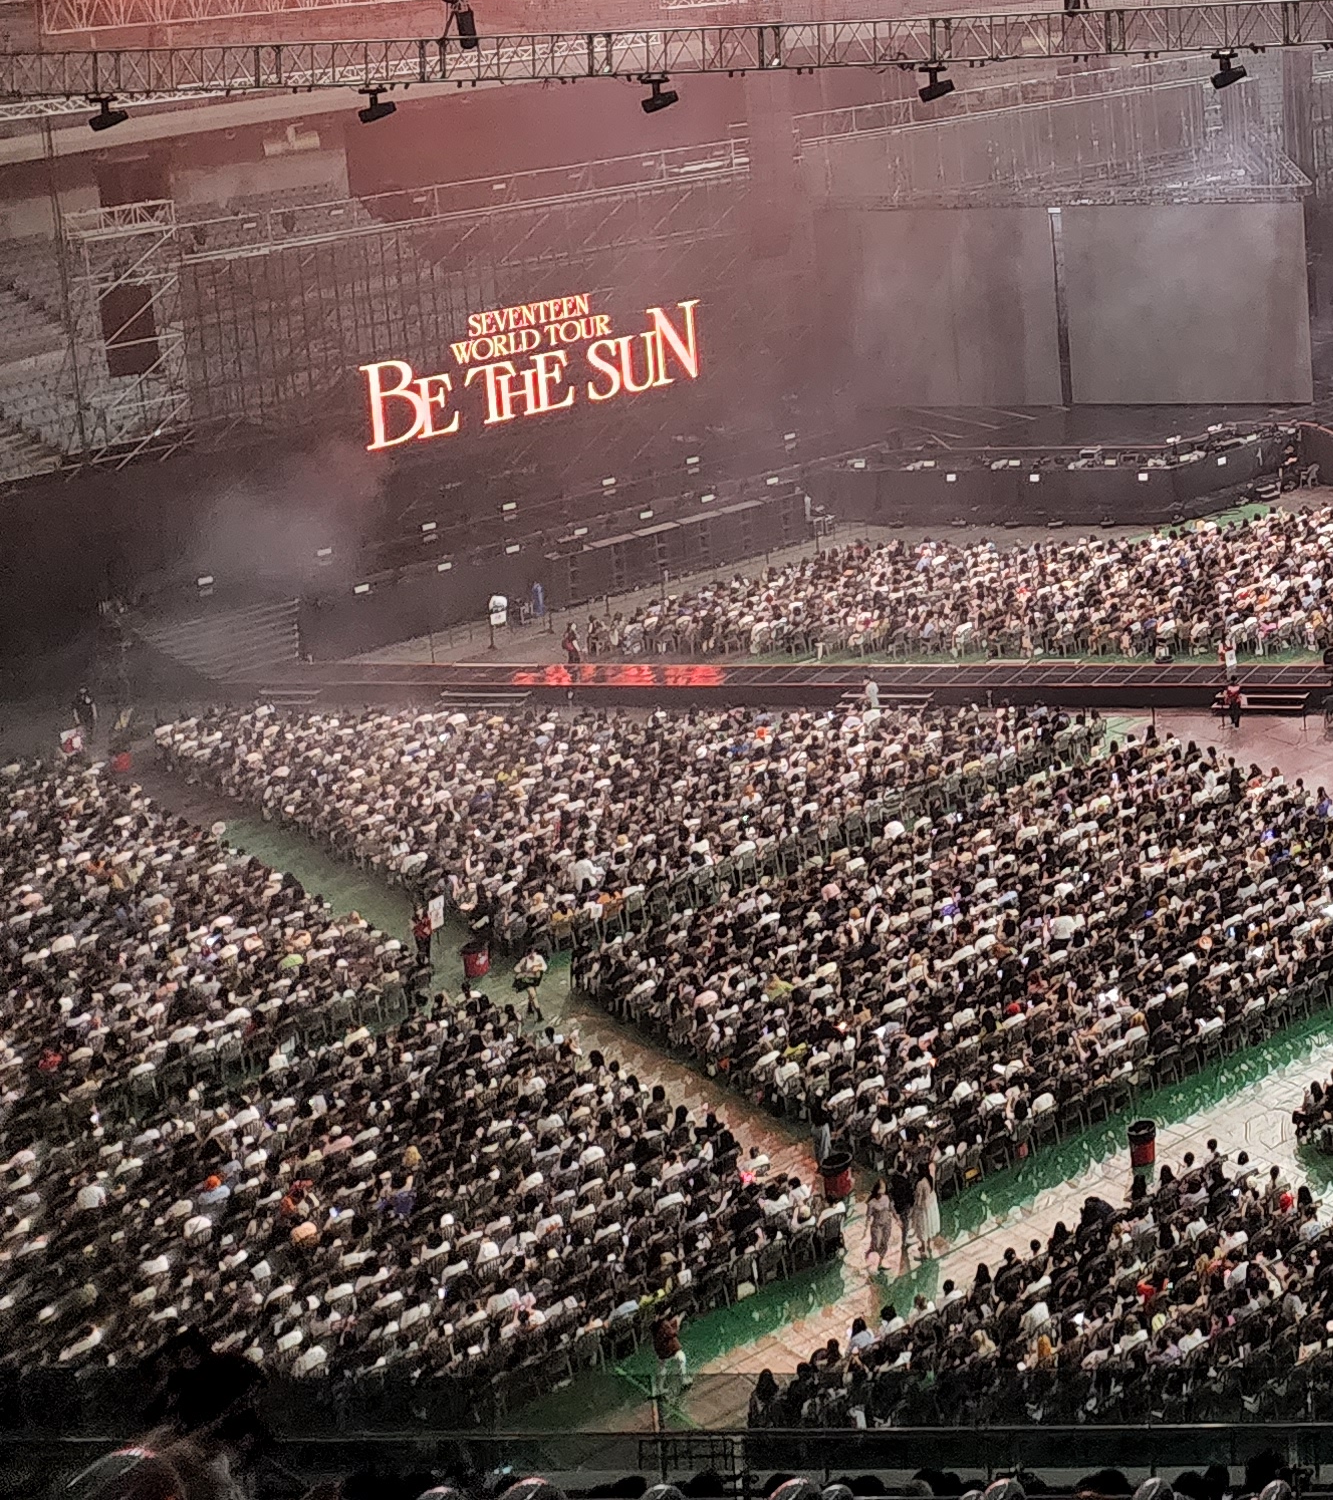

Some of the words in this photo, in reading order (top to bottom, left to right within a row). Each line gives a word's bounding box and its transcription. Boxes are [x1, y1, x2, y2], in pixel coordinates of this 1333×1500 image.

[450, 328, 541, 364] WORLD
[543, 314, 613, 347] TOUR
[468, 293, 591, 337] SEVENTEEN
[359, 360, 460, 450] BE
[464, 350, 575, 425] THE
[586, 299, 700, 401] SUN
